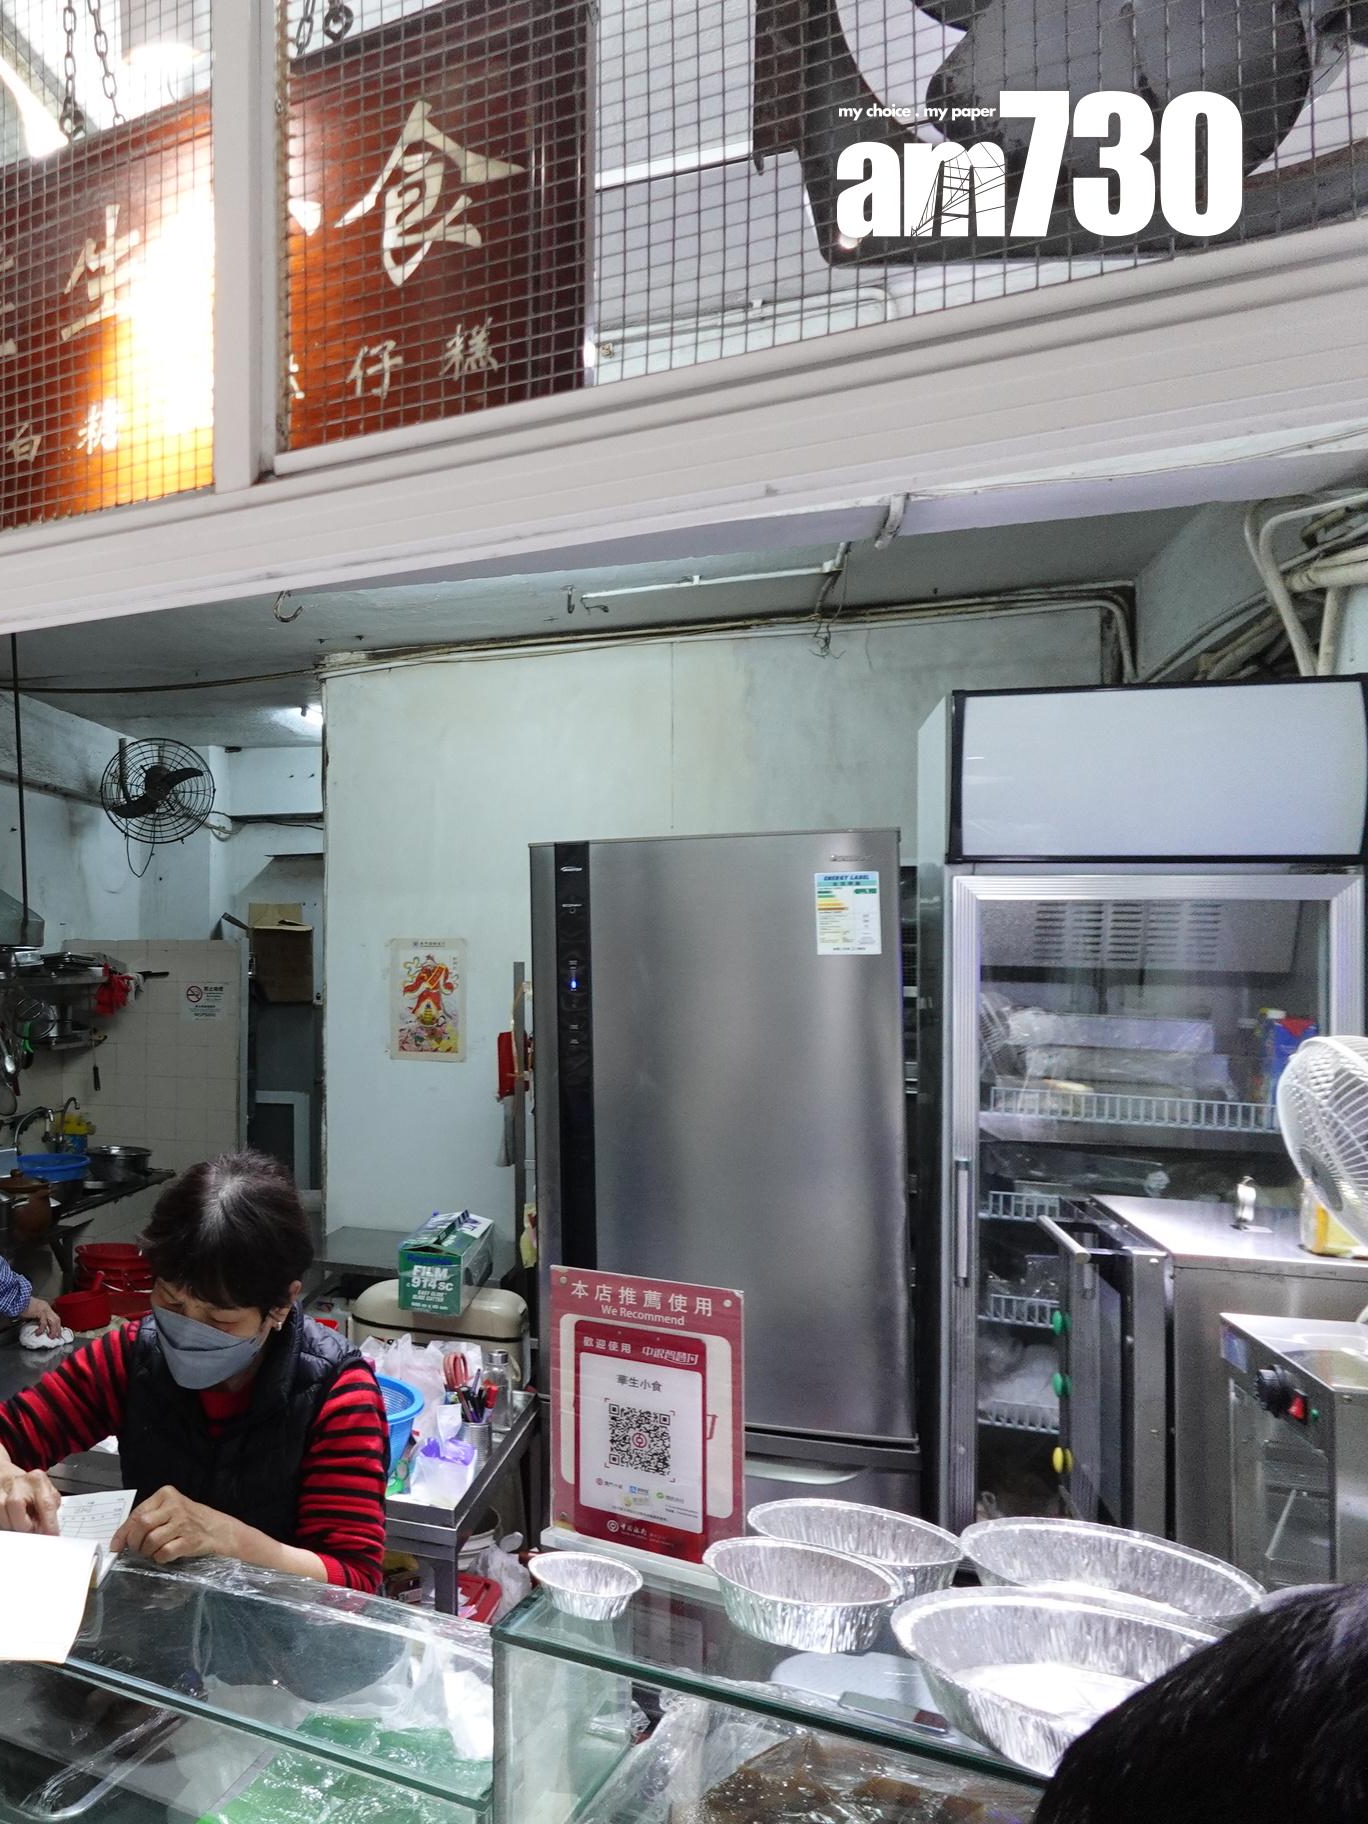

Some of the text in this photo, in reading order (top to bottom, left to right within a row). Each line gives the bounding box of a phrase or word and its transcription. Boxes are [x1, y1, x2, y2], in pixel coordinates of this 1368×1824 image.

[413, 1265, 448, 1280] FILM
[571, 1280, 712, 1317] 本店推薦使用
[601, 1304, 685, 1326] We Recommend
[616, 1374, 663, 1392] 華生小食
